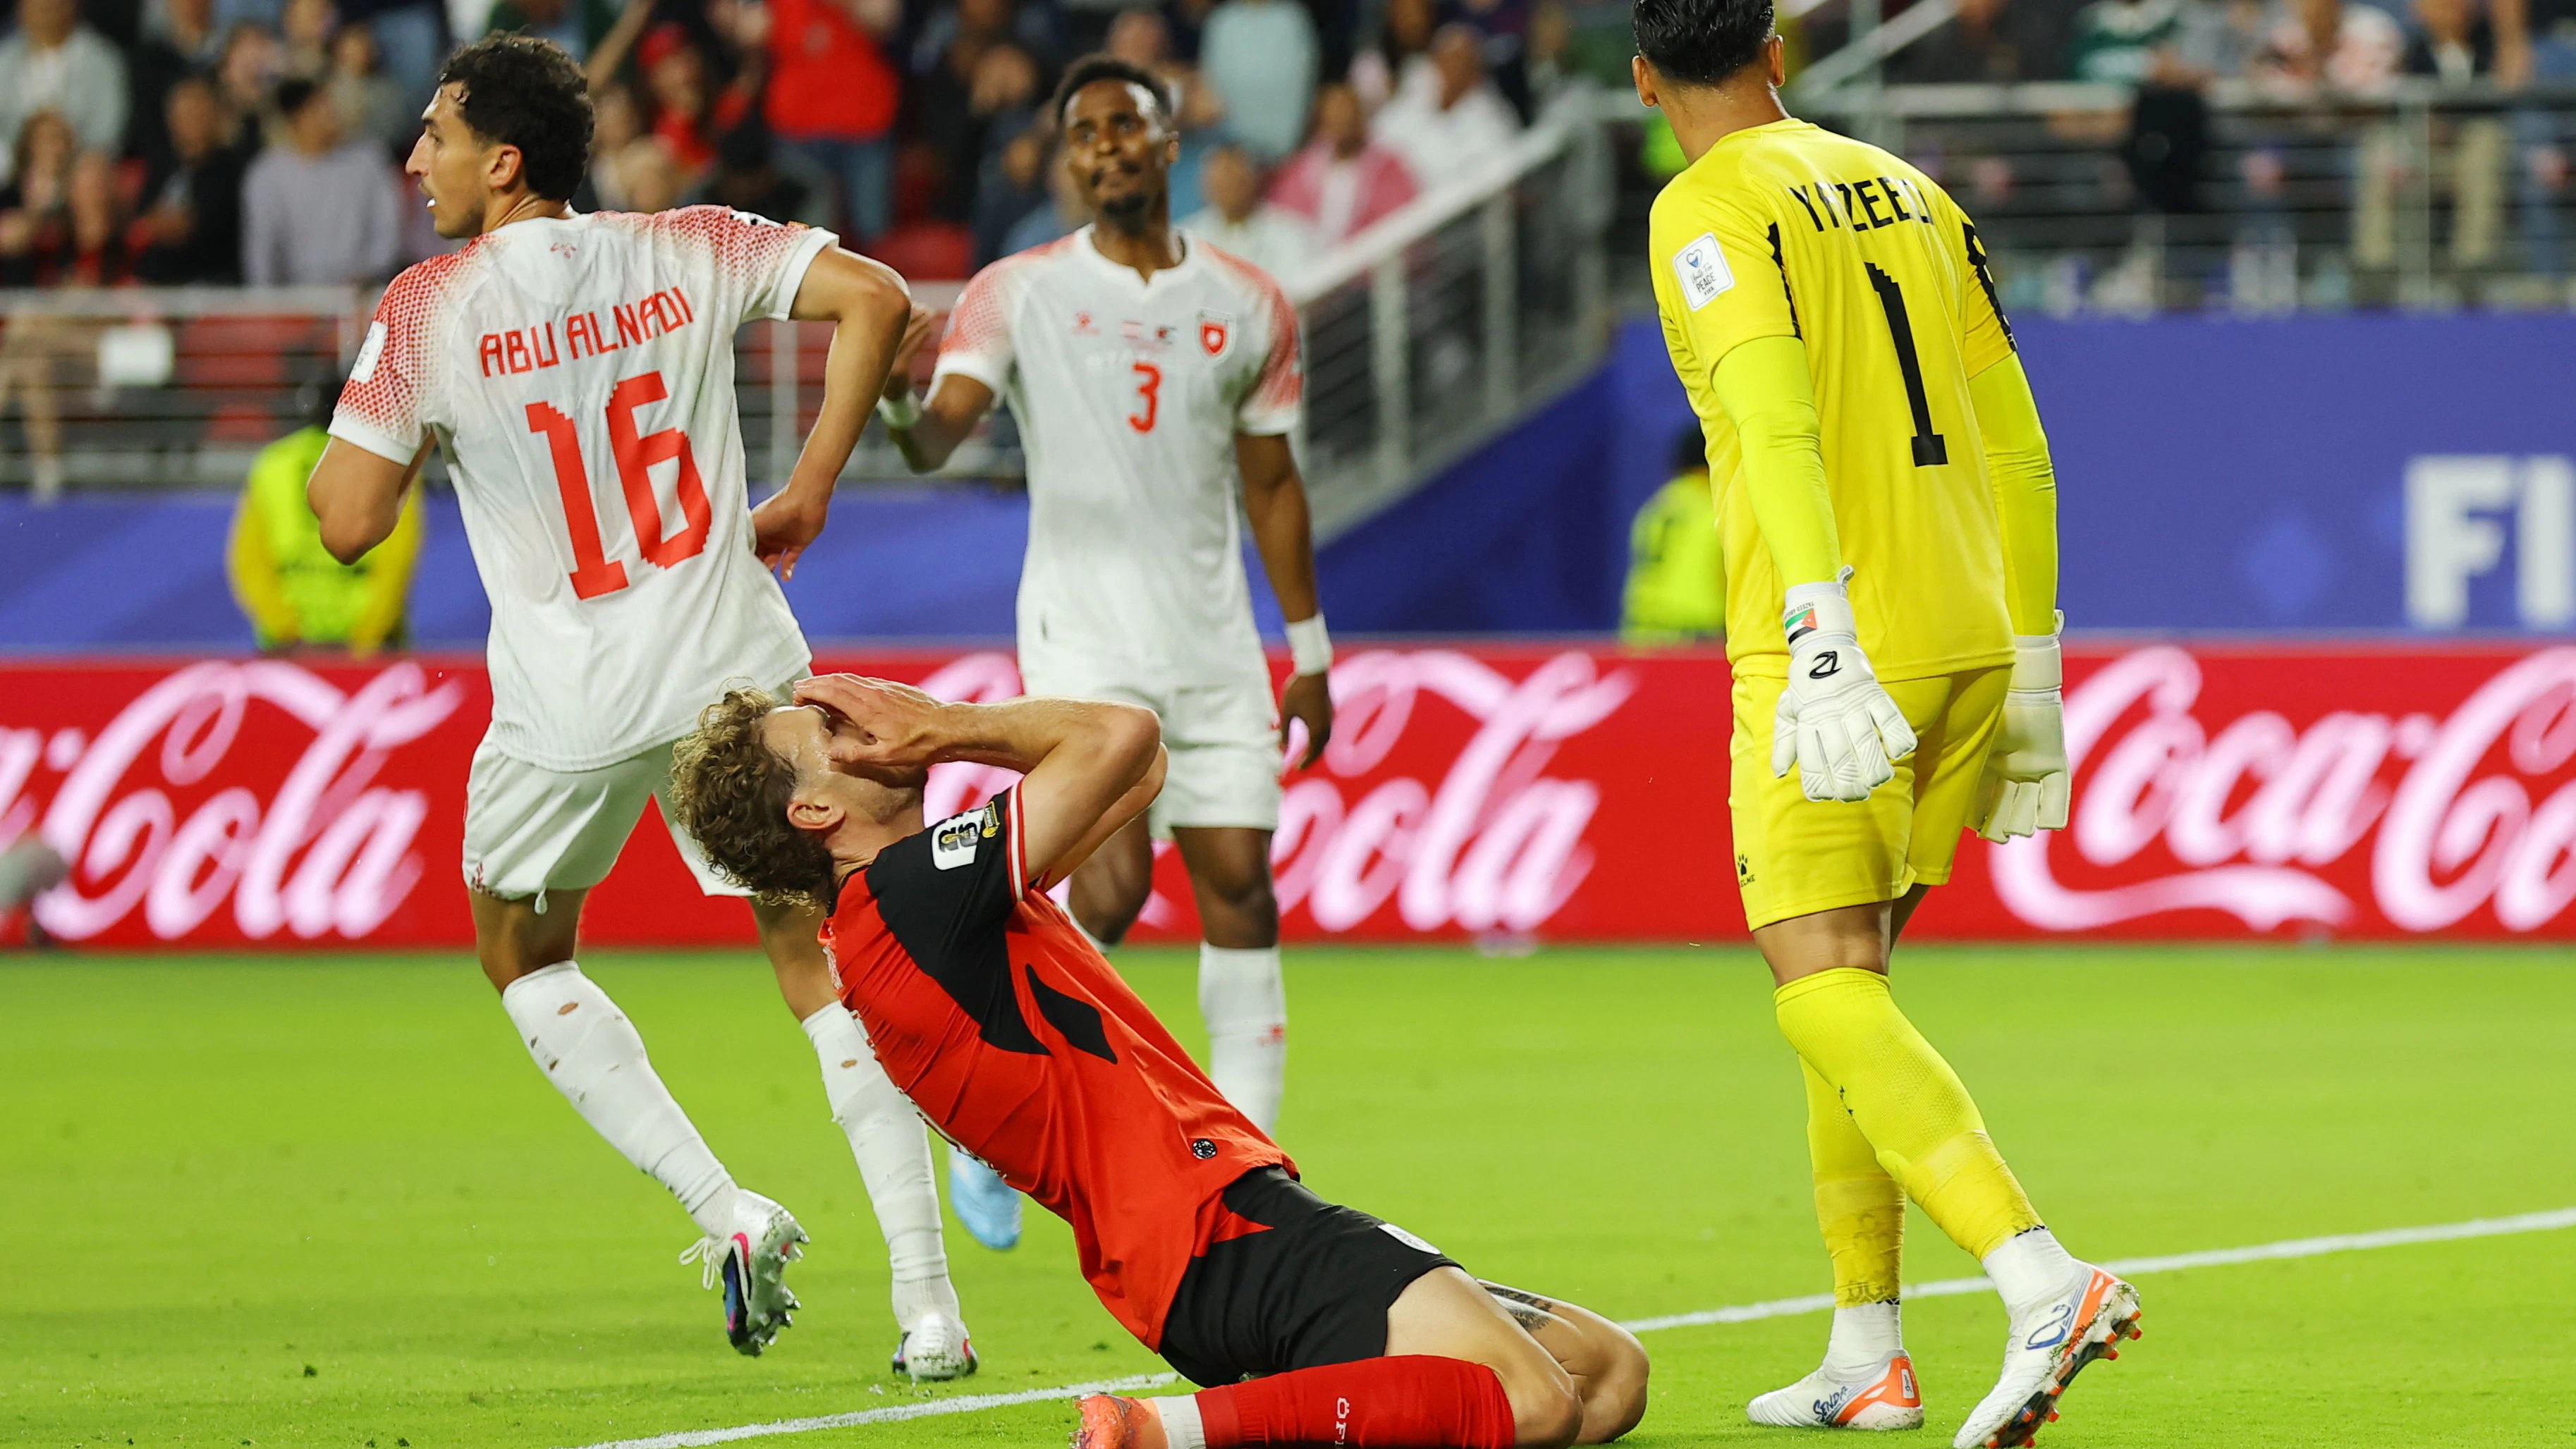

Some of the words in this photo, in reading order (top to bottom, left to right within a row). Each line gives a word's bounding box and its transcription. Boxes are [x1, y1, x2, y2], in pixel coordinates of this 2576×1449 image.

[1696, 272, 1717, 293] PEACE
[1704, 286, 1715, 296] FIFA
[480, 322, 560, 377] ABU
[566, 286, 694, 360] ALNADI
[1863, 262, 1948, 467] 1
[1128, 360, 1161, 435] 3
[525, 370, 712, 600] 16
[2403, 453, 2576, 630] FI
[1987, 643, 2576, 934] Coca-Co
[1335, 1397, 1350, 1445] ÖF
